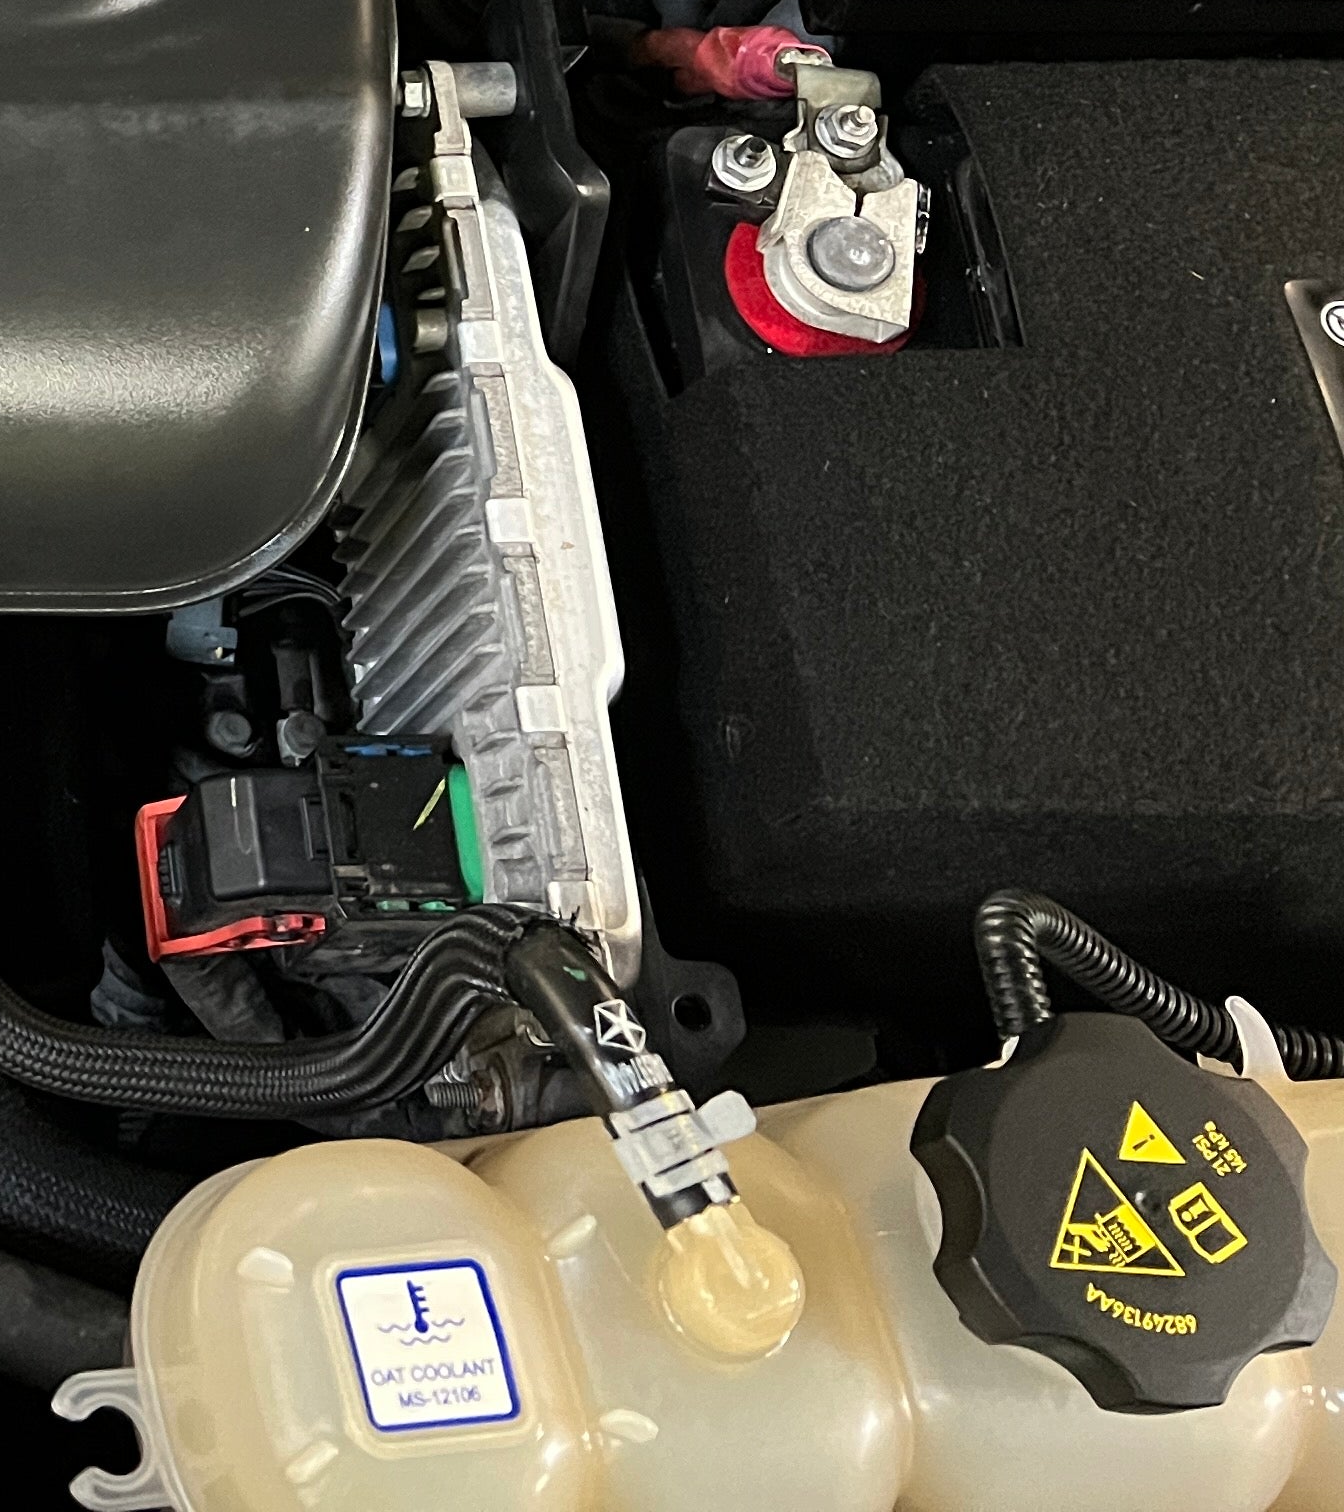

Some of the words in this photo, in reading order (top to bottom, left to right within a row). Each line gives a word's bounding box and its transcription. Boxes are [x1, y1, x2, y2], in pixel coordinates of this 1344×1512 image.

[1192, 1134, 1218, 1160] PSI
[1212, 1158, 1231, 1177] 21
[1086, 1282, 1197, 1334] 68249136AA
[371, 1368, 404, 1386] OAT
[411, 1359, 494, 1382] COOLANT
[399, 1385, 481, 1407] MS-12106
